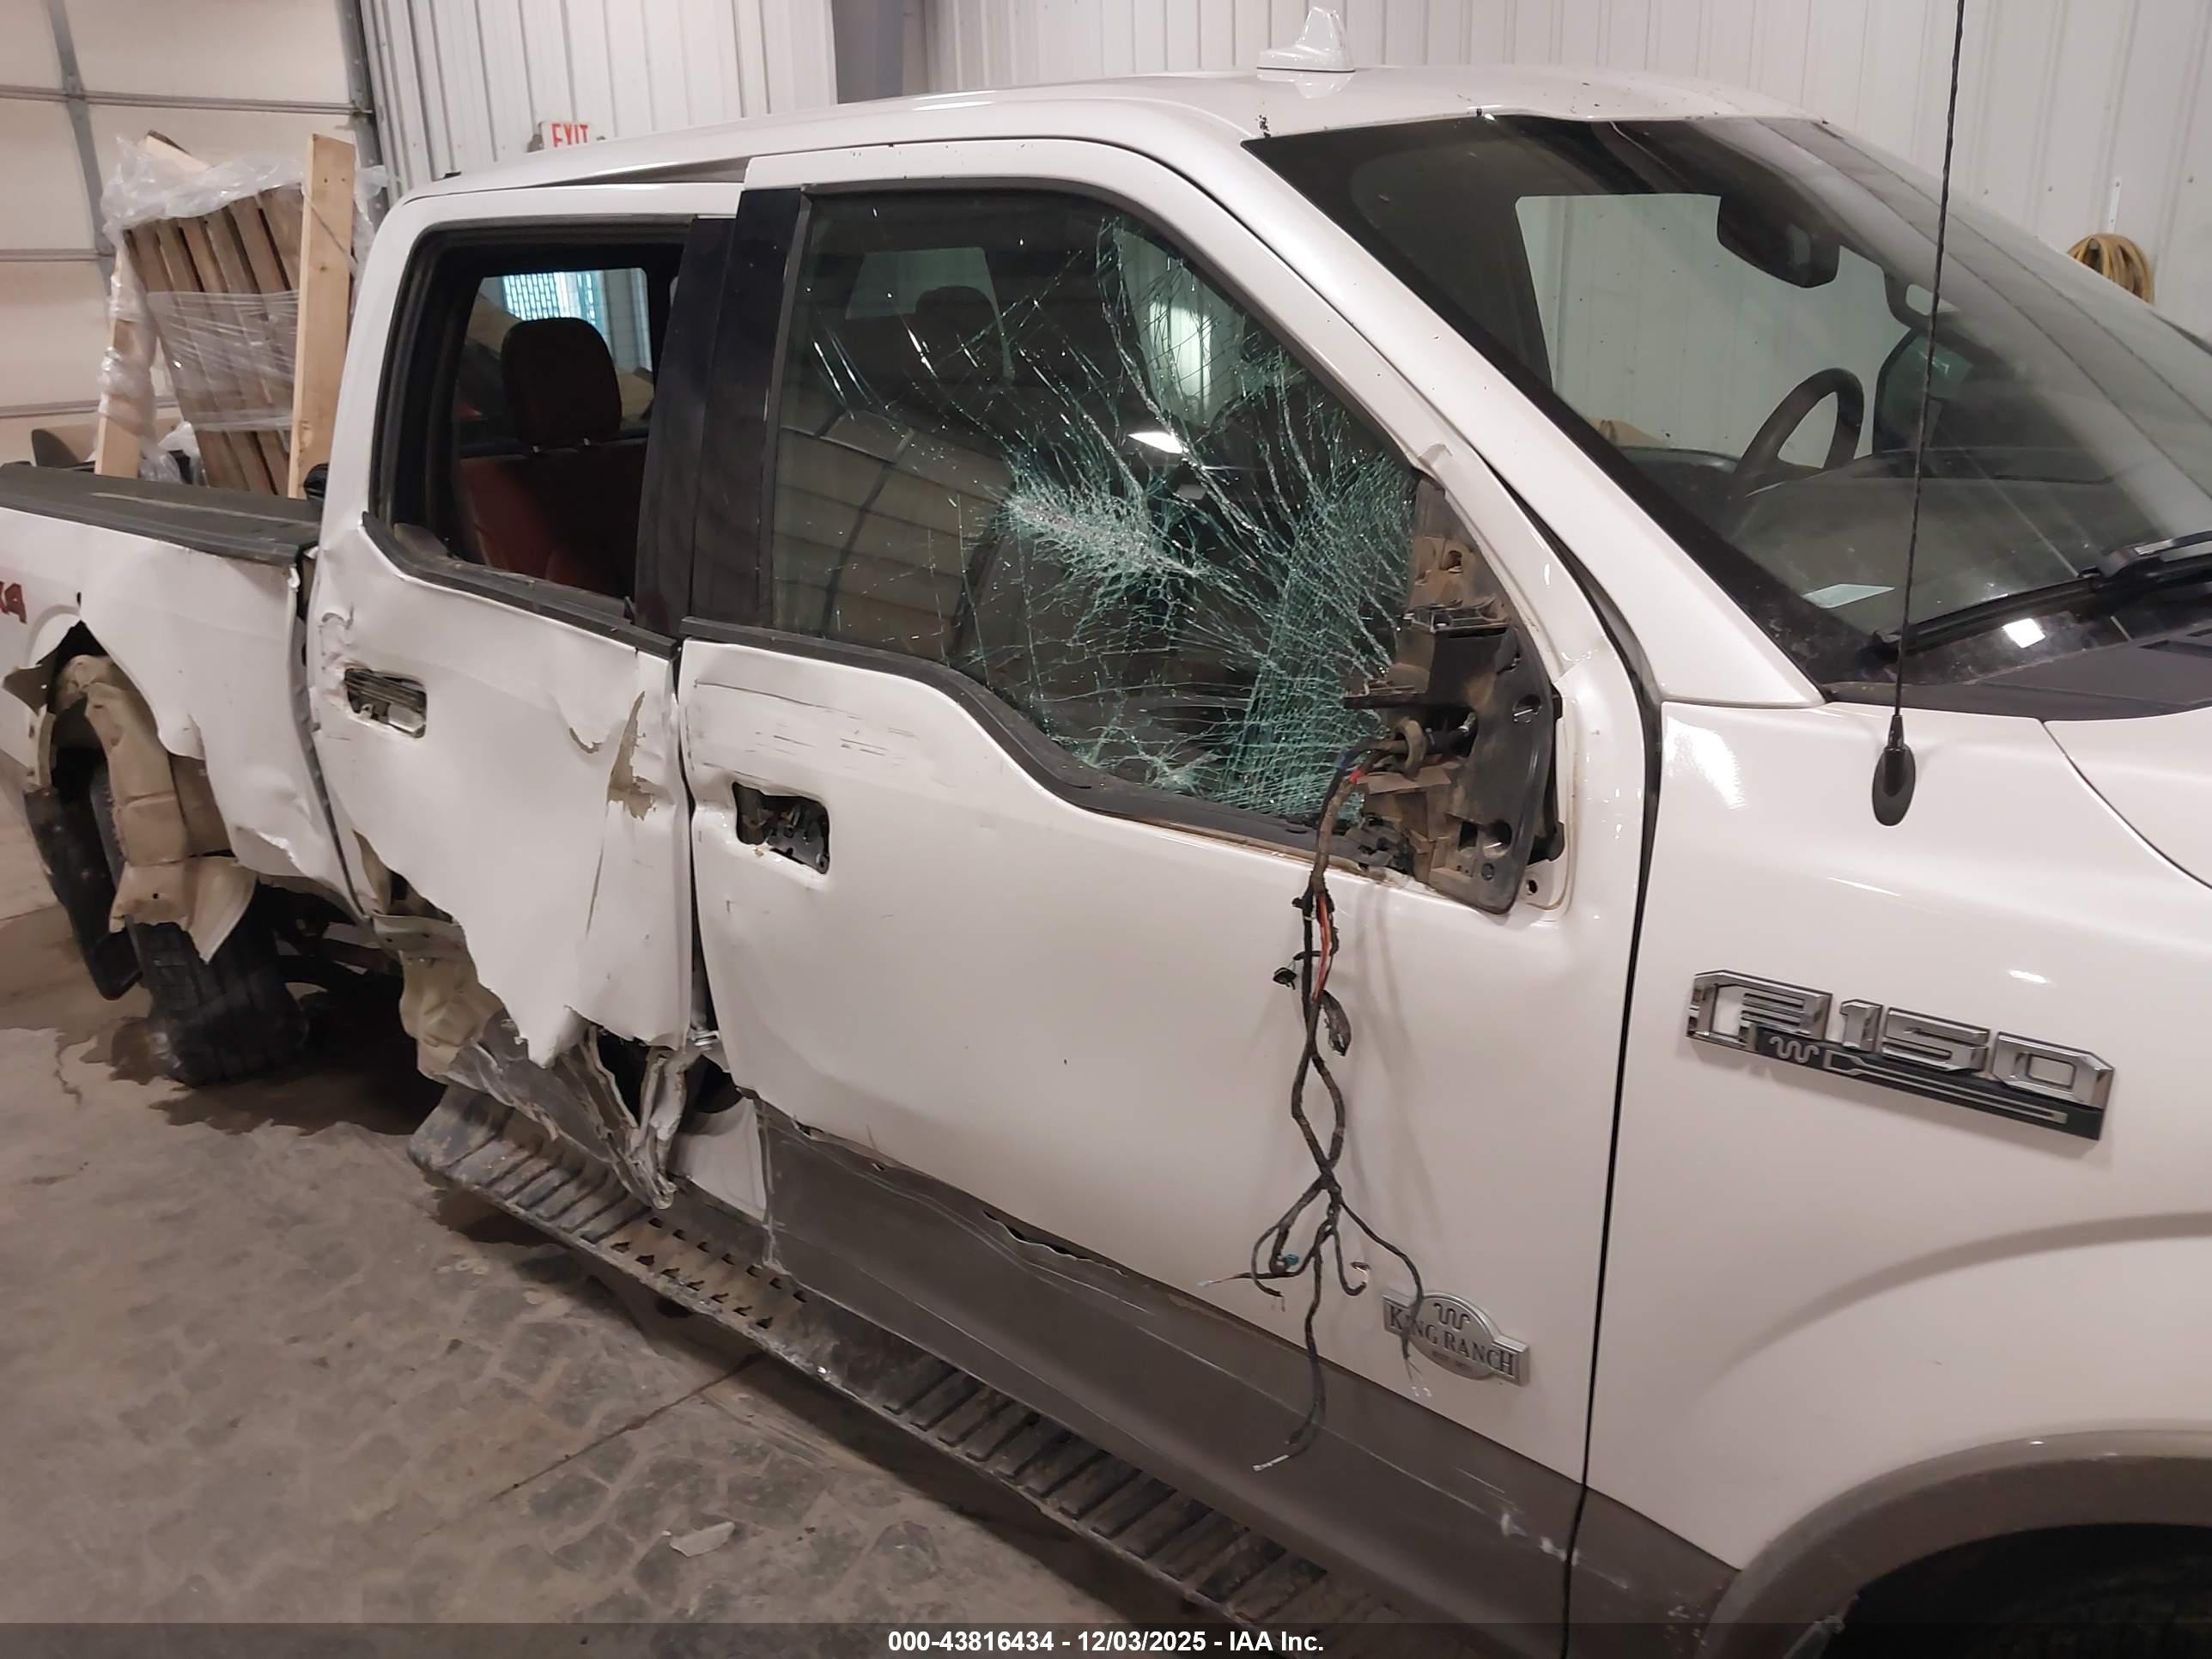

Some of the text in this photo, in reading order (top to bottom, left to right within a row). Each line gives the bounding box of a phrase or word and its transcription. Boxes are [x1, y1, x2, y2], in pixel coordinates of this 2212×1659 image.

[551, 123, 588, 148] EXIT
[1389, 1304, 1438, 1345] KNG
[1443, 1330, 1514, 1376] RANCH
